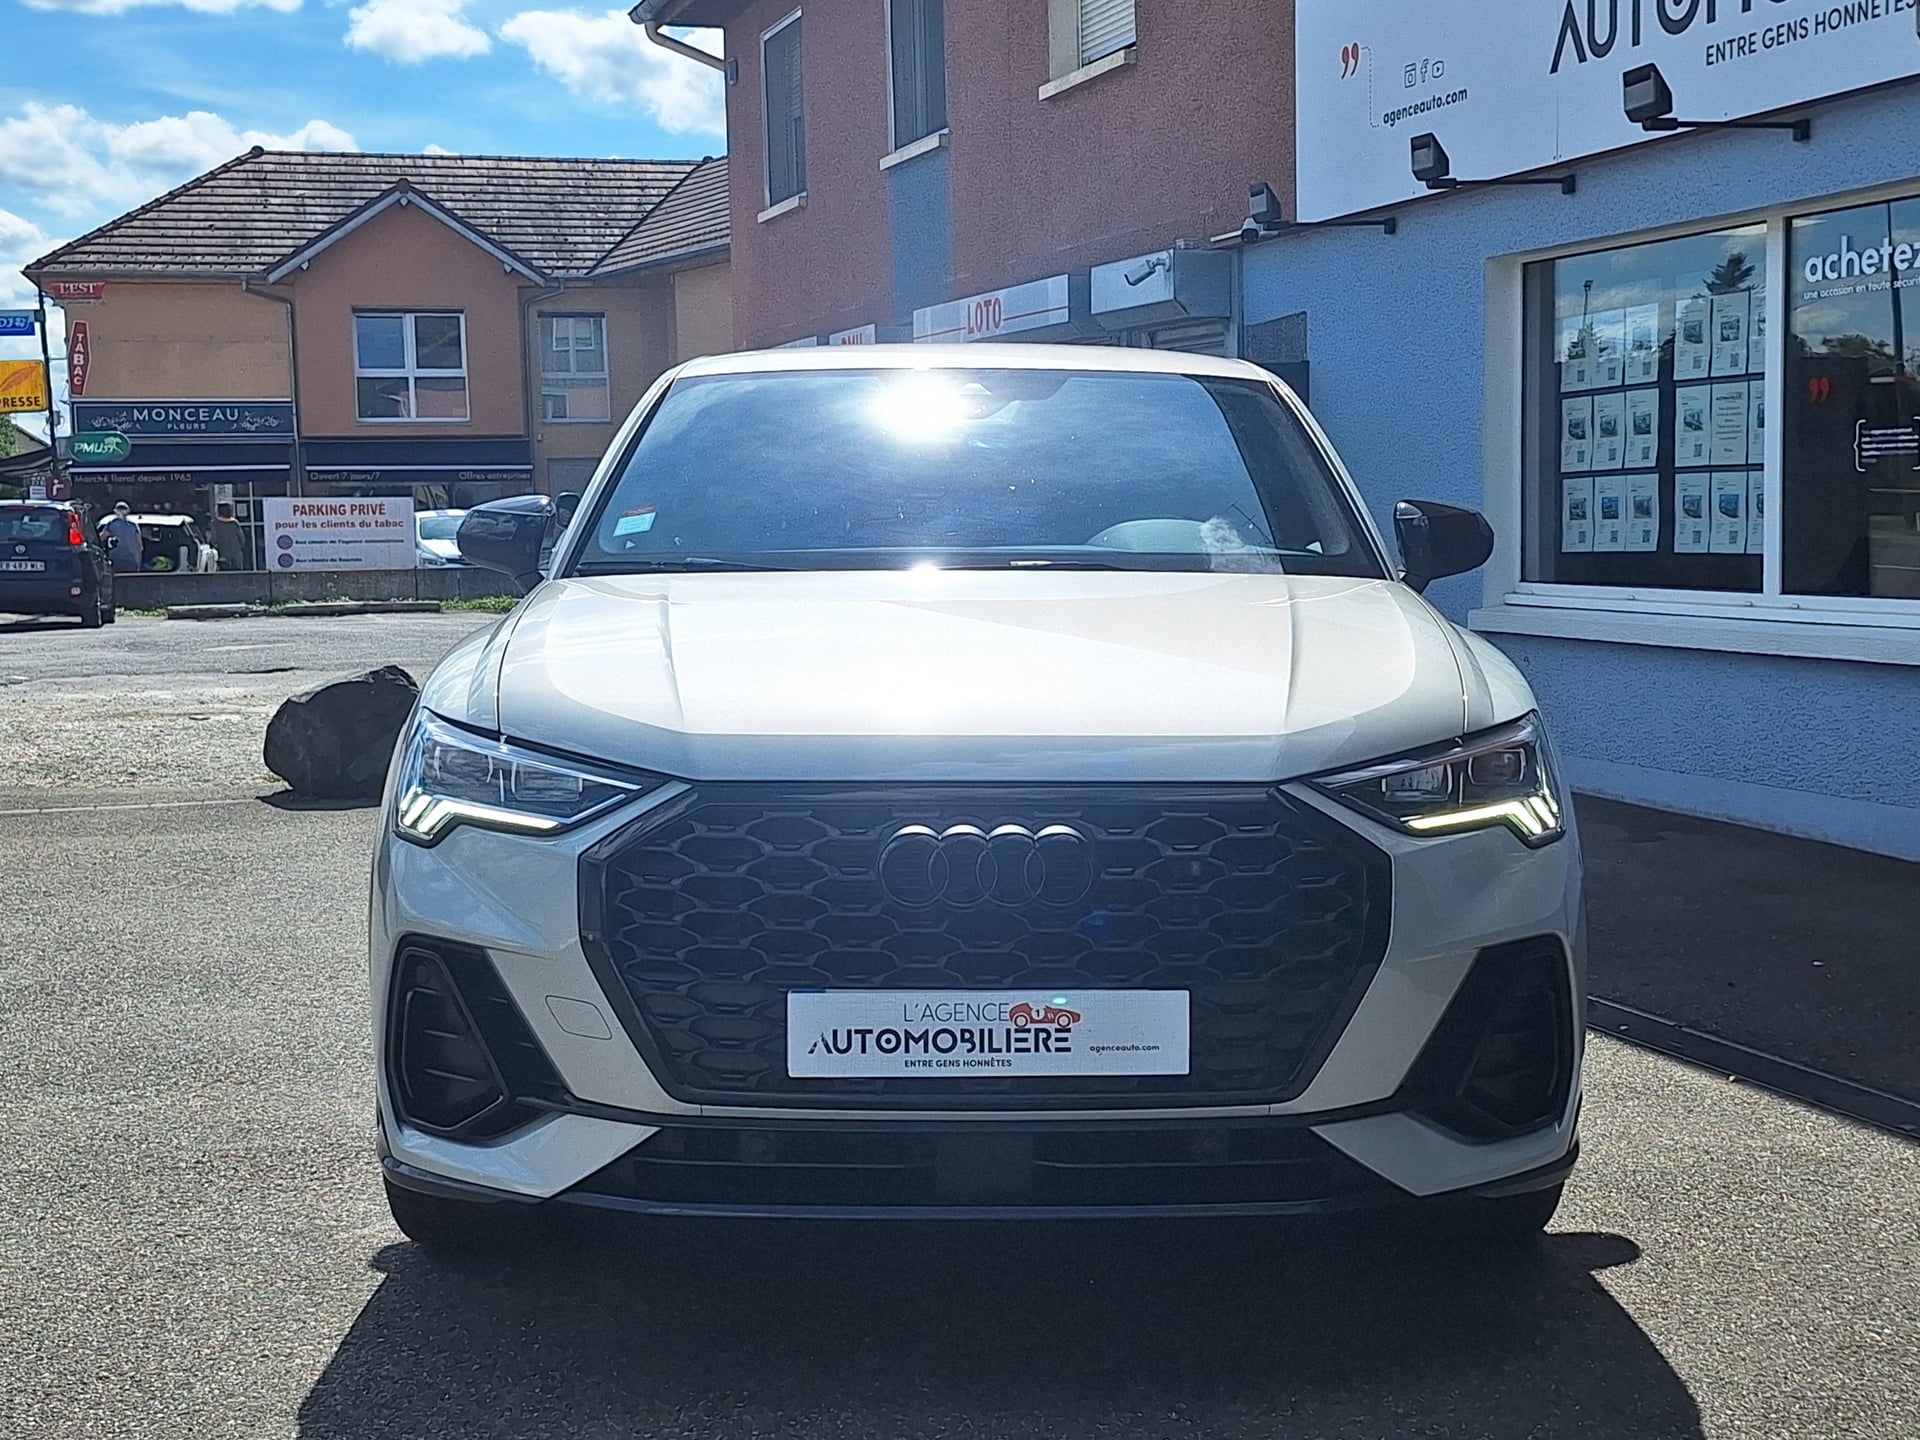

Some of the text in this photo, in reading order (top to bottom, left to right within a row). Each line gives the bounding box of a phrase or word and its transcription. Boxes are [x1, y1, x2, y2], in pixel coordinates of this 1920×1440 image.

[1706, 31, 1758, 66] ENTRE
[1762, 16, 1809, 51] GENS
[1383, 88, 1468, 127] agenceauto.com
[1820, 284, 1853, 298] occasion
[1856, 285, 1866, 293] en
[967, 298, 1001, 335] LOTO
[73, 333, 84, 385] TABAC
[133, 408, 239, 421] MONCEAU
[170, 472, 191, 481] 1965
[292, 500, 387, 517] PARKING PRIVÉ
[275, 518, 404, 530] pour les clients du tabac
[903, 1002, 1010, 1022] L'AGENCE
[1089, 1044, 1160, 1054] agenceauto.com
[904, 1057, 1013, 1068] ENTRE GENS HONNÊTES
